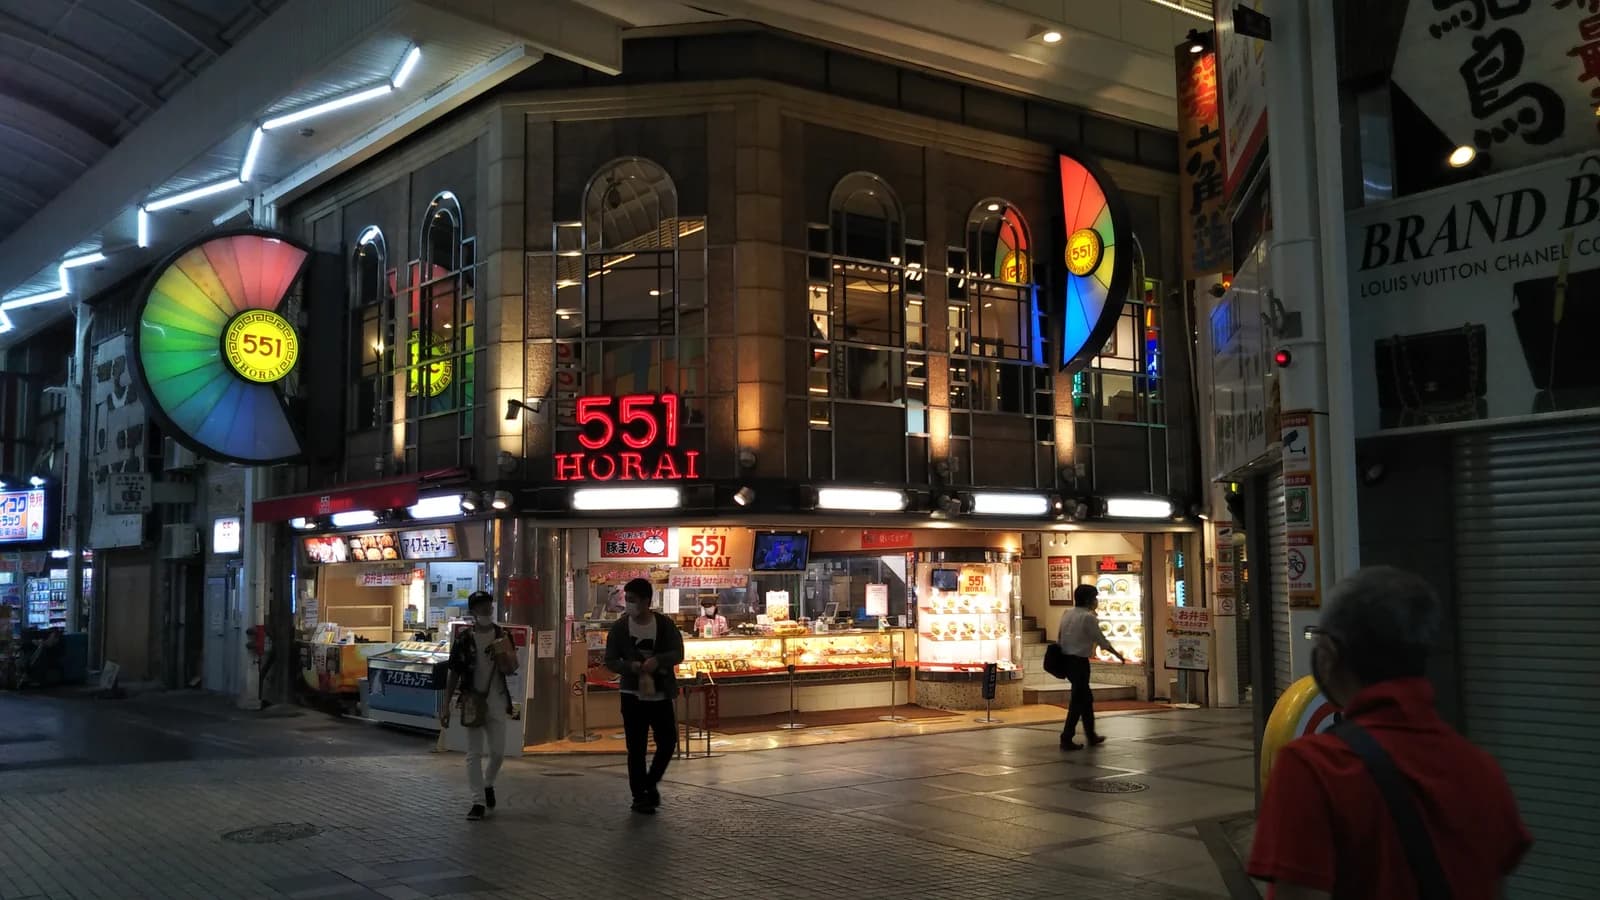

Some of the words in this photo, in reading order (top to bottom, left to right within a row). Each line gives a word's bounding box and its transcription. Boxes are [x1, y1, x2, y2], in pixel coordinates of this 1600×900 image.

[1358, 188, 1547, 272] BRAND
[1558, 173, 1600, 230] B
[1072, 245, 1091, 260] 551
[1361, 275, 1408, 298] LOUIS
[1412, 259, 1487, 286] VUITTON
[1495, 242, 1570, 271] CHANEL
[243, 334, 282, 358] 551
[239, 363, 282, 379] HORAI
[576, 393, 679, 449] 551
[554, 451, 699, 480] HORAI
[402, 536, 455, 553] アイスキャンデー
[606, 541, 640, 554] 豚まん
[691, 535, 726, 555] 551
[682, 556, 731, 567] HORAI
[671, 576, 701, 587] お弁当
[969, 576, 983, 586] 551
[1179, 610, 1208, 621] お弁当
[386, 670, 433, 687] アイスキャンデー
